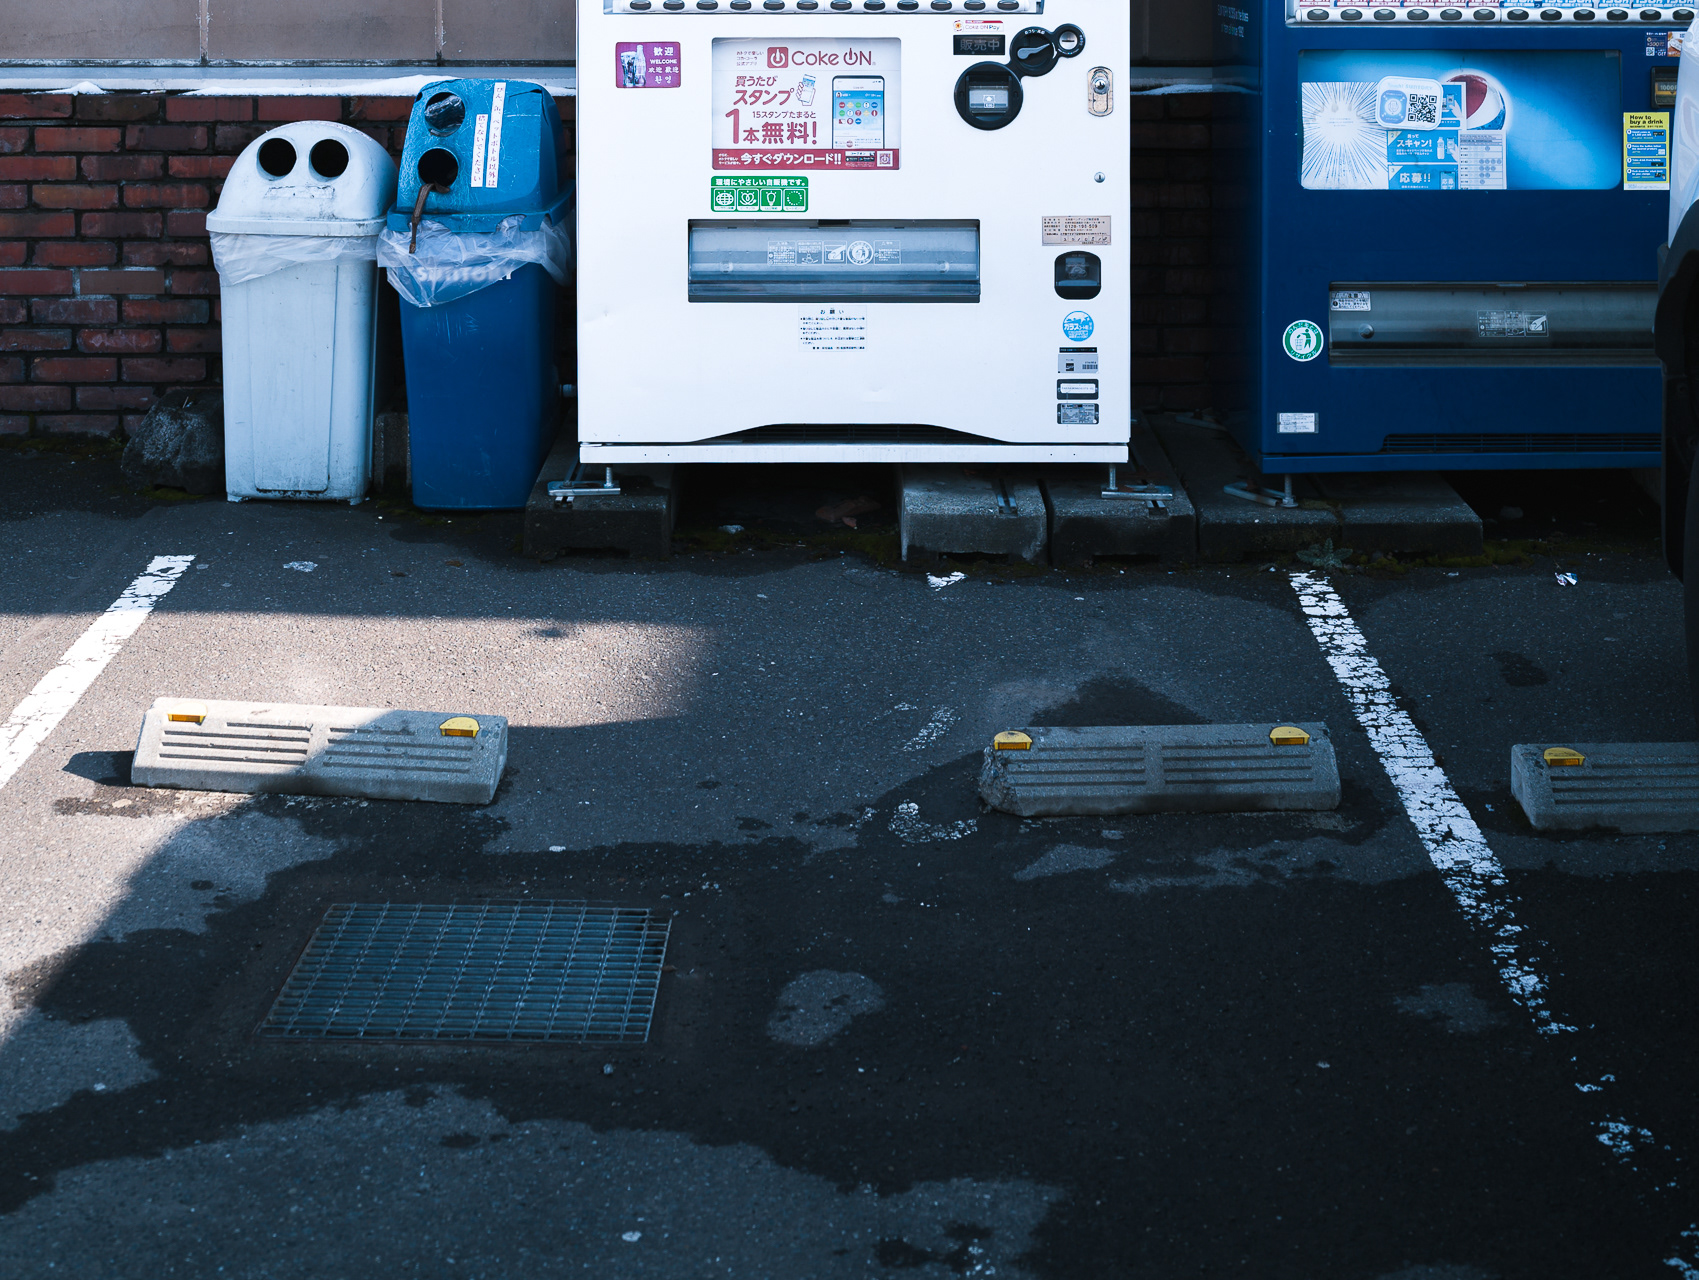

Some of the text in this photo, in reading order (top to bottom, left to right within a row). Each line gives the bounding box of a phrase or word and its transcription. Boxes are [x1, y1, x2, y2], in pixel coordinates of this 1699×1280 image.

[960, 39, 1000, 51] 販売中
[791, 47, 873, 66] Coke ON
[735, 75, 778, 87] 買うたび
[733, 88, 795, 106] スタンプ
[752, 110, 817, 119] 15スタンプたまると
[725, 108, 817, 145] 1本無料!
[1397, 139, 1432, 147] スキャン!
[740, 153, 842, 165] 今すぐダウンロード!!
[716, 178, 806, 187] 環境にやさしい自販機です。
[1399, 173, 1431, 183] 応募!!
[1290, 350, 1317, 359] リサイクル
